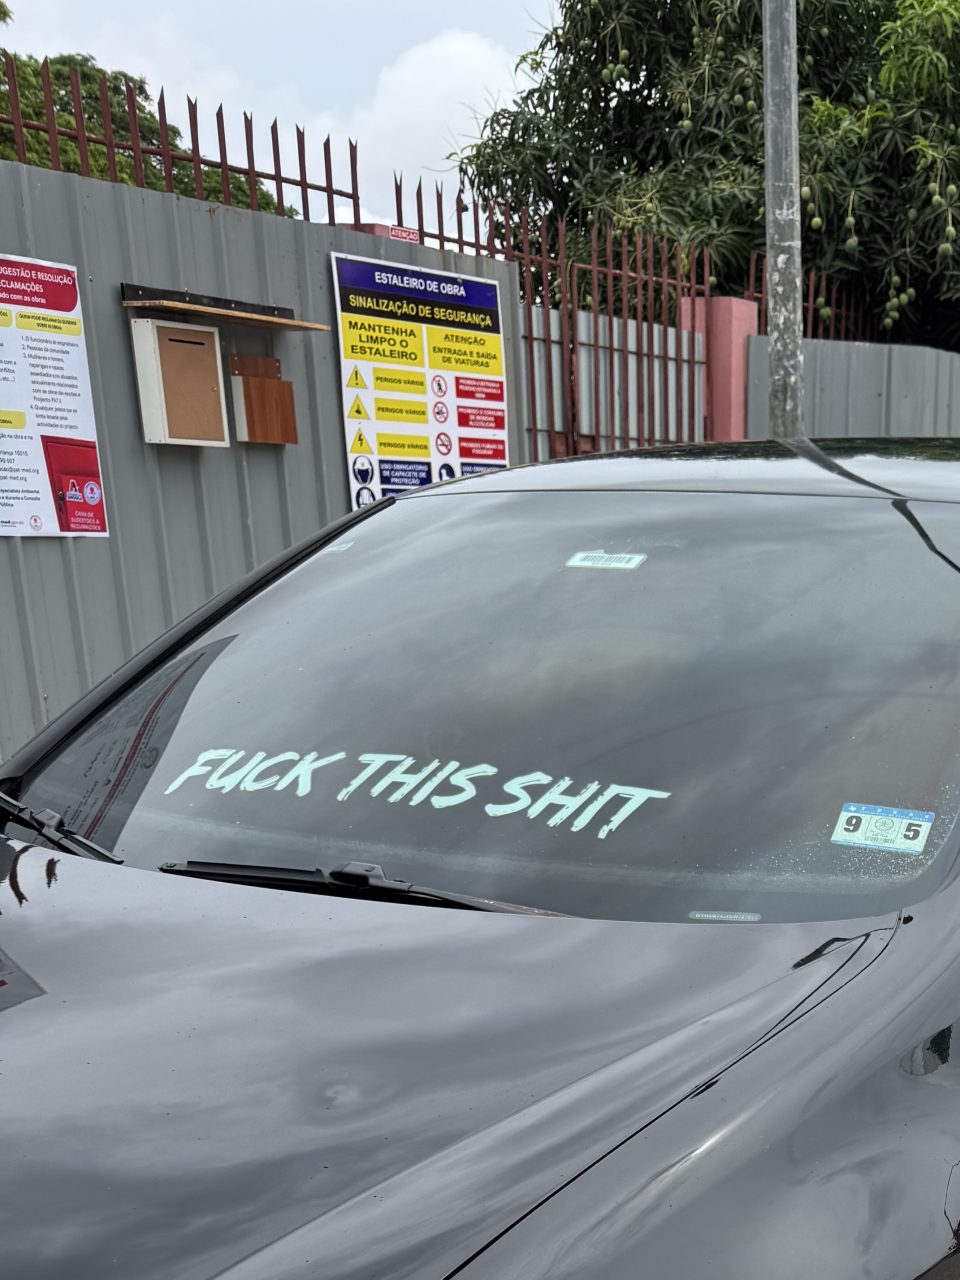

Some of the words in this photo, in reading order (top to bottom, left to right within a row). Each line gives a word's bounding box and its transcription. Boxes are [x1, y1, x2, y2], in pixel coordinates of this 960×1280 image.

[391, 228, 418, 240] ATENÇÃO
[32, 271, 37, 279] E
[38, 272, 73, 286] RESOLUÇÃO
[375, 271, 426, 291] ESTALEIRO
[426, 280, 439, 292] DE
[440, 282, 466, 297] OBRA
[31, 296, 46, 304] obras
[349, 294, 417, 316] SINALIZAÇÃO
[418, 305, 432, 318] DE
[434, 307, 492, 328] SEGURANÇA
[348, 320, 417, 338] MANTENHA
[358, 334, 396, 347] LIMPO
[399, 339, 409, 348] O
[443, 334, 486, 346] ATENÇÃO
[351, 345, 418, 361] ESTALEIRO
[432, 346, 468, 356] ENTRADA
[476, 350, 498, 360] SAÍDA
[442, 356, 453, 364] DE
[454, 357, 490, 368] VIATURAS
[376, 376, 402, 384] PERIGOS
[403, 378, 424, 387] VÁRIOS
[405, 408, 426, 416] VÁRIOS
[164, 748, 347, 797] FUCK
[337, 753, 498, 809] THIS
[485, 771, 673, 840] SHIT
[843, 815, 863, 833] 9
[903, 822, 922, 841] 5
